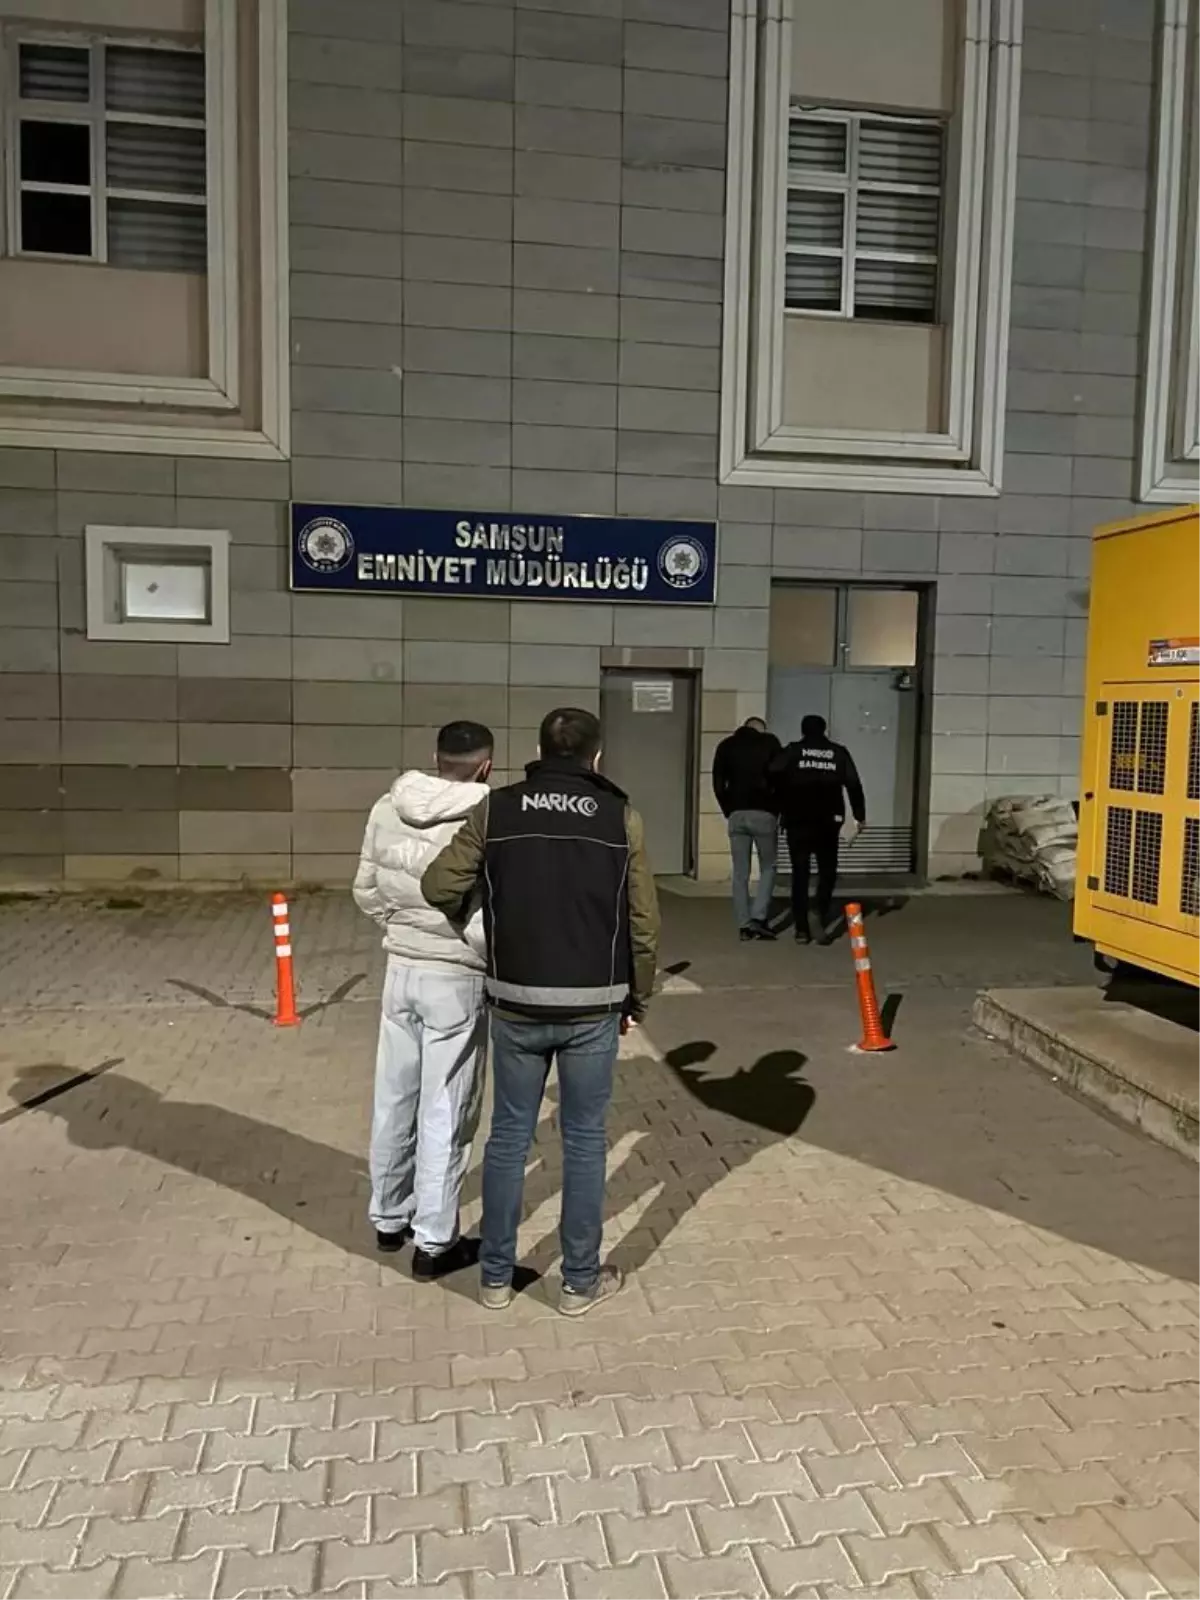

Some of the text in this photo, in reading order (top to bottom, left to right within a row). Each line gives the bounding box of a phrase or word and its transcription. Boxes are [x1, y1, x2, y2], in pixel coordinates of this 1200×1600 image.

[455, 520, 564, 553] SAMSUN
[357, 549, 476, 585] EMNİYET
[486, 553, 648, 591] MÜDÜRLÜĞÜ
